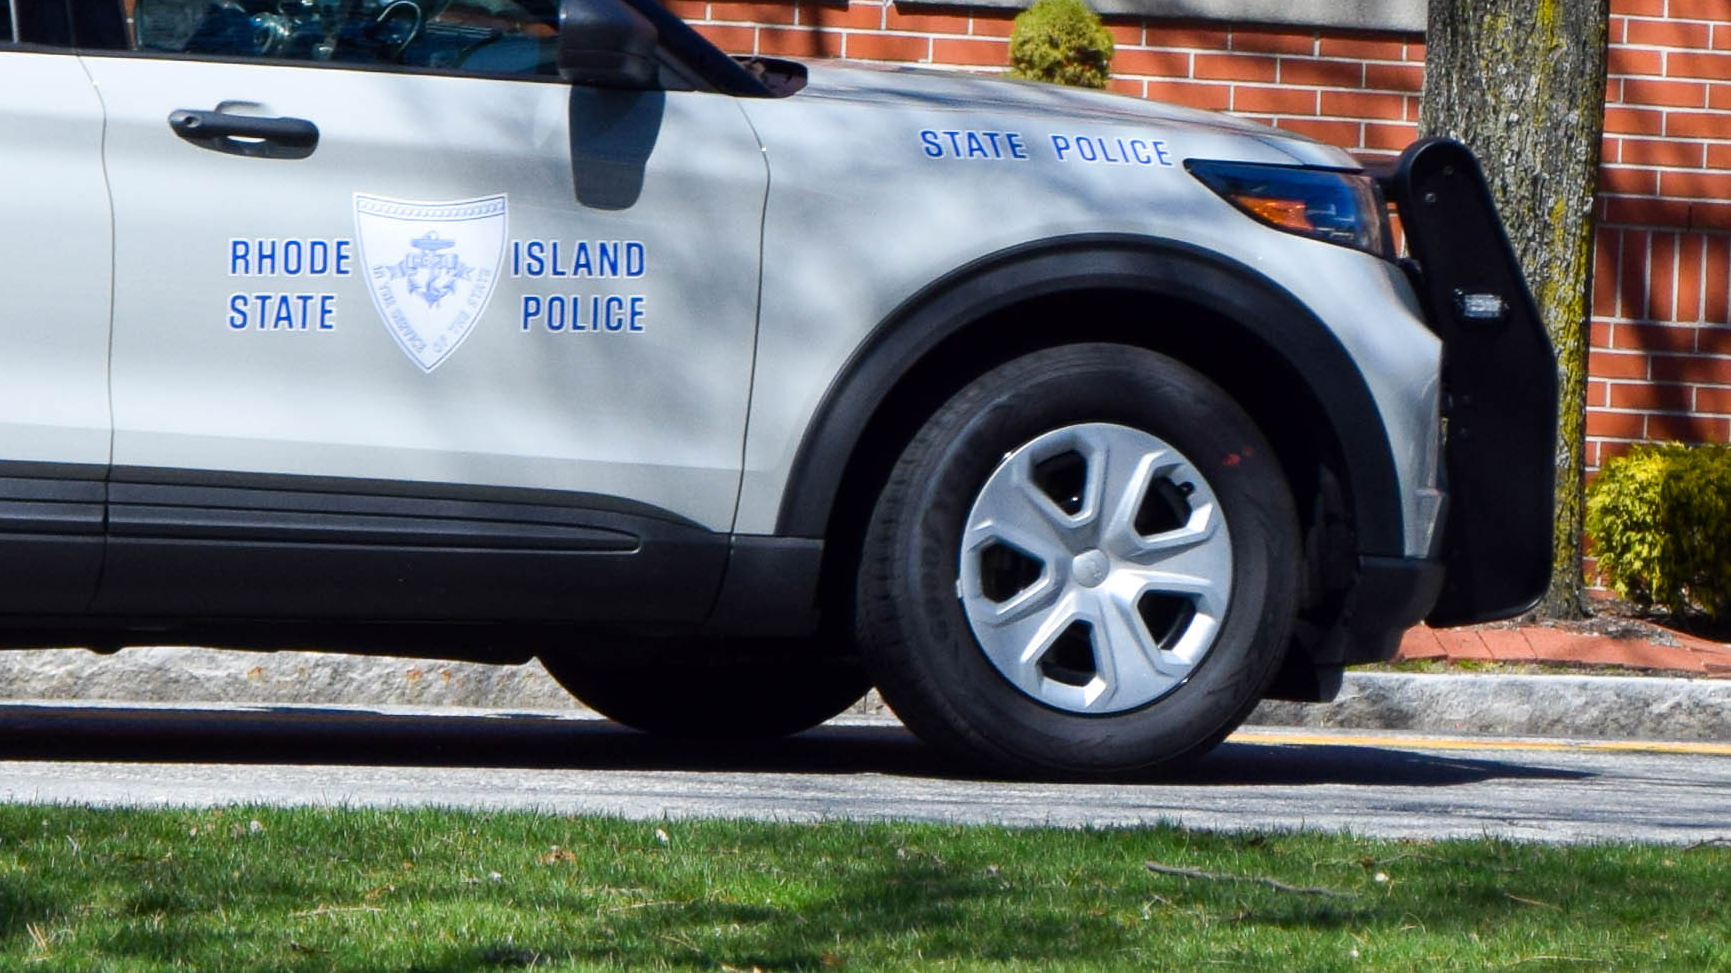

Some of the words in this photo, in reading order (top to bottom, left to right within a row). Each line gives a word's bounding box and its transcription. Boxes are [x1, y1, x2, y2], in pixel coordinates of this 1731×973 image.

[920, 130, 1027, 159] STATE
[1050, 135, 1173, 166] POLICE
[231, 240, 350, 275] RHODE
[513, 241, 644, 276] ISLAND
[230, 294, 334, 329] STATE
[523, 296, 644, 331] POLICE
